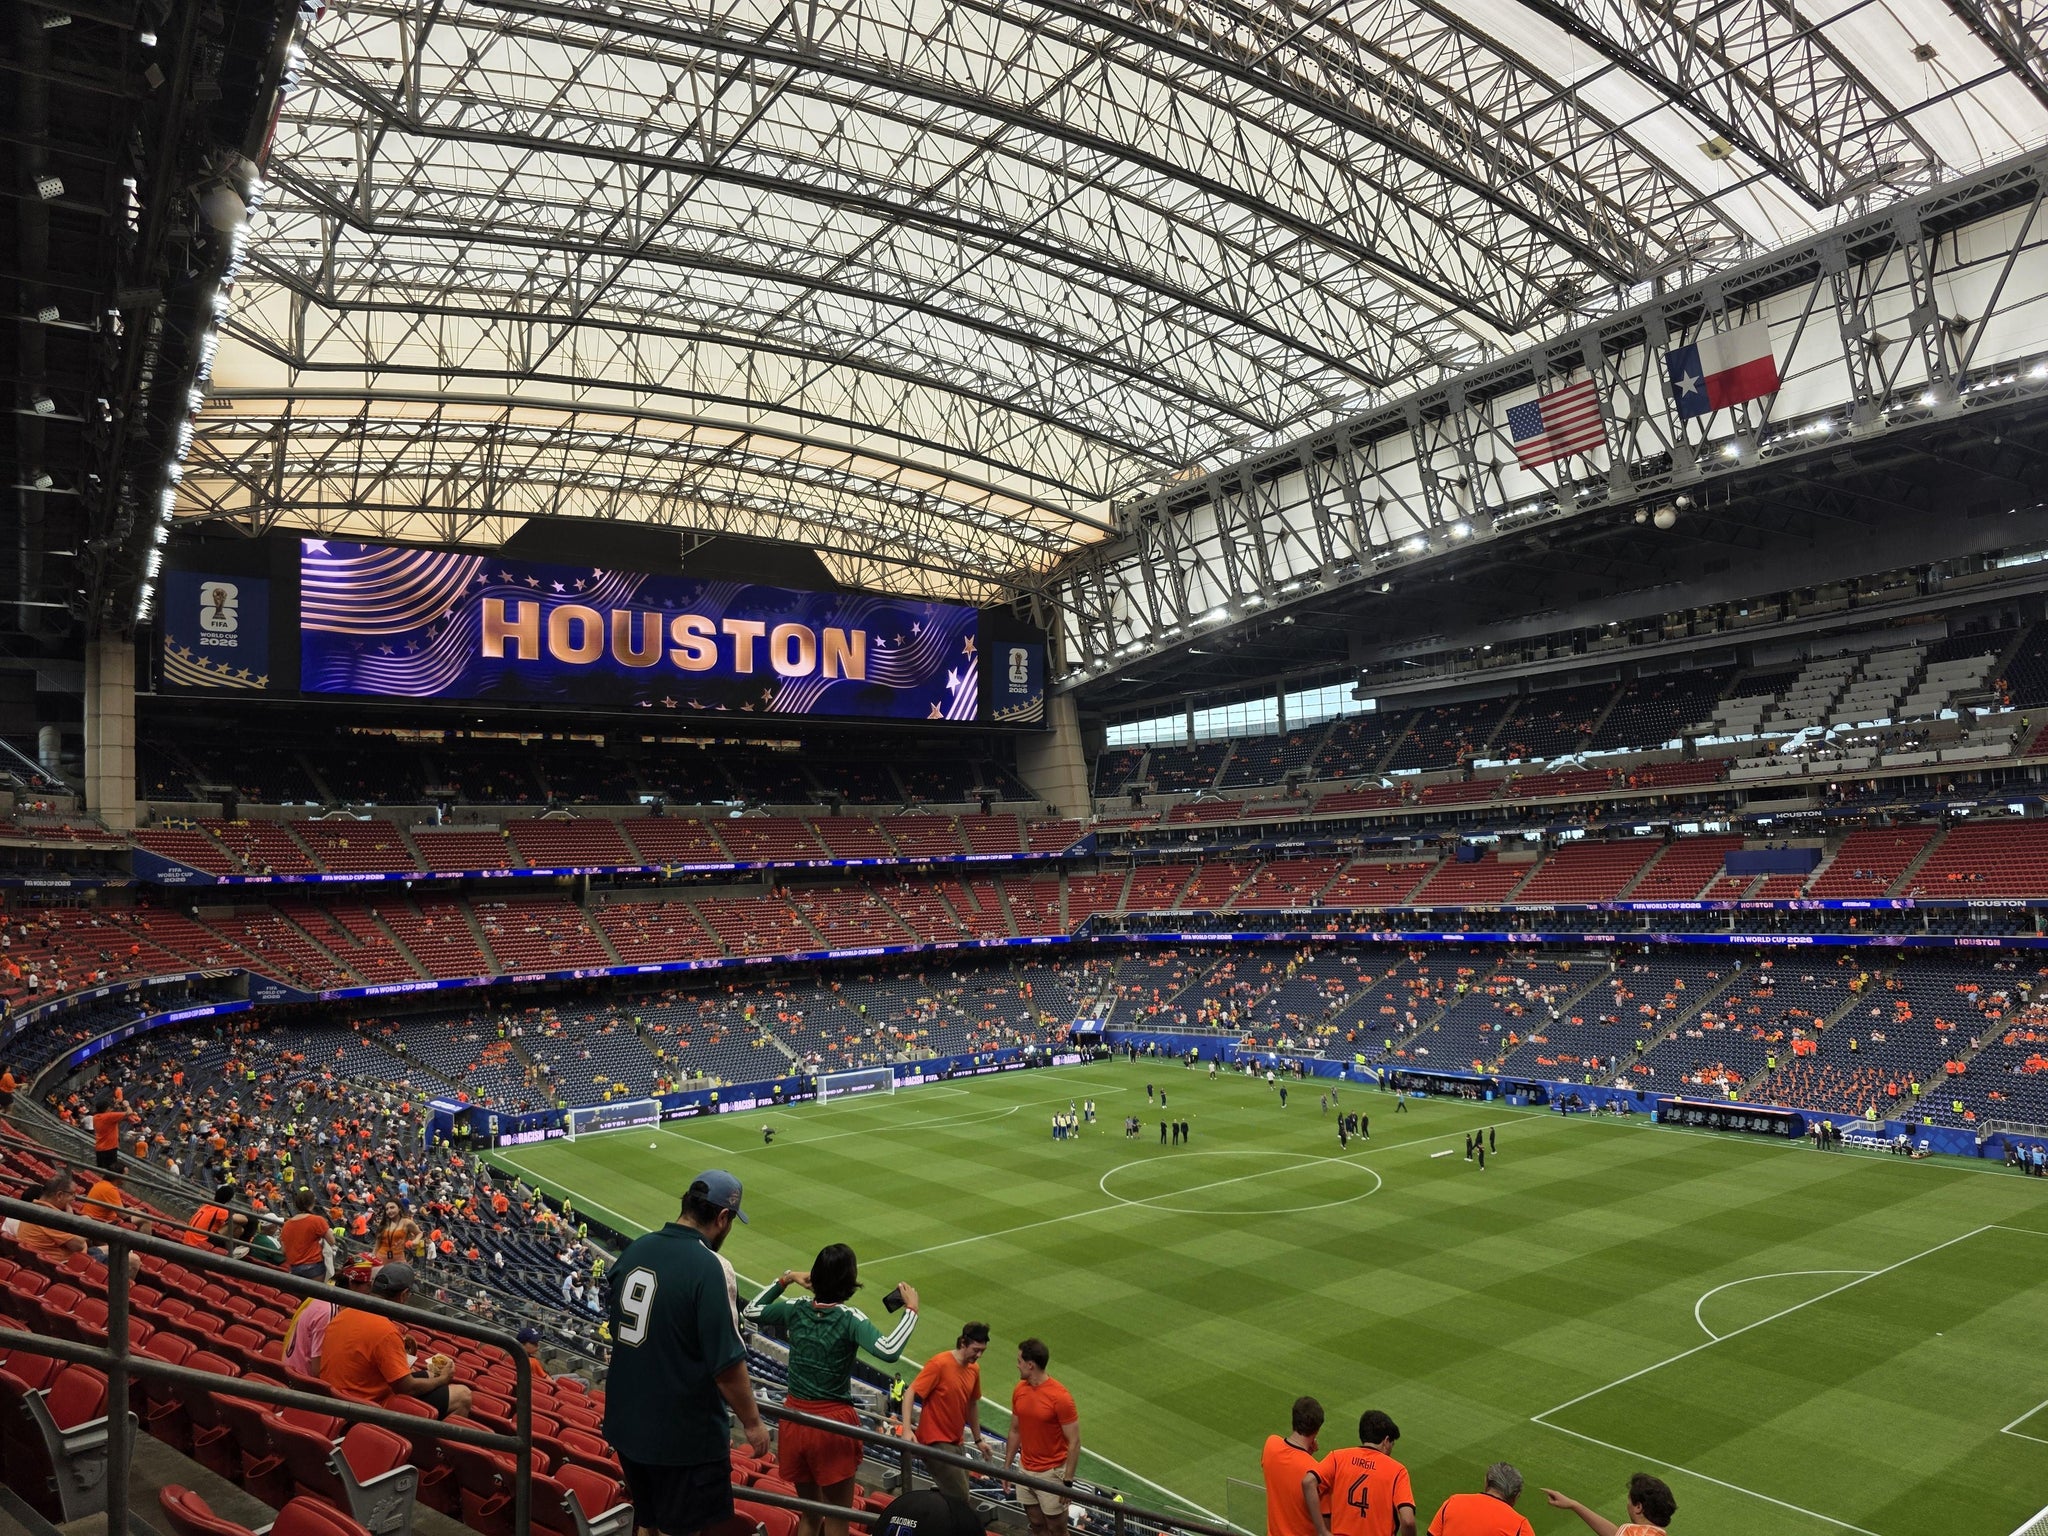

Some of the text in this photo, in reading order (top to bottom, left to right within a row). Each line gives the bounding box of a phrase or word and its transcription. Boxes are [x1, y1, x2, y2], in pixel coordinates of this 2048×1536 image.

[200, 638, 238, 647] 2026
[481, 596, 867, 681] HOUSTON
[1775, 810, 1823, 819] HOUSTON
[1955, 938, 2000, 946] HOUSTON
[379, 986, 400, 994] WORLD
[415, 982, 438, 990] 2026
[720, 1099, 756, 1113] NO RACISM
[758, 1098, 773, 1106] FIFA
[600, 1121, 627, 1129] LISTEN
[500, 1130, 545, 1147] NO RACISM
[547, 1129, 564, 1138] FIFA
[618, 1266, 658, 1348] 9
[1348, 1474, 1369, 1518] 4
